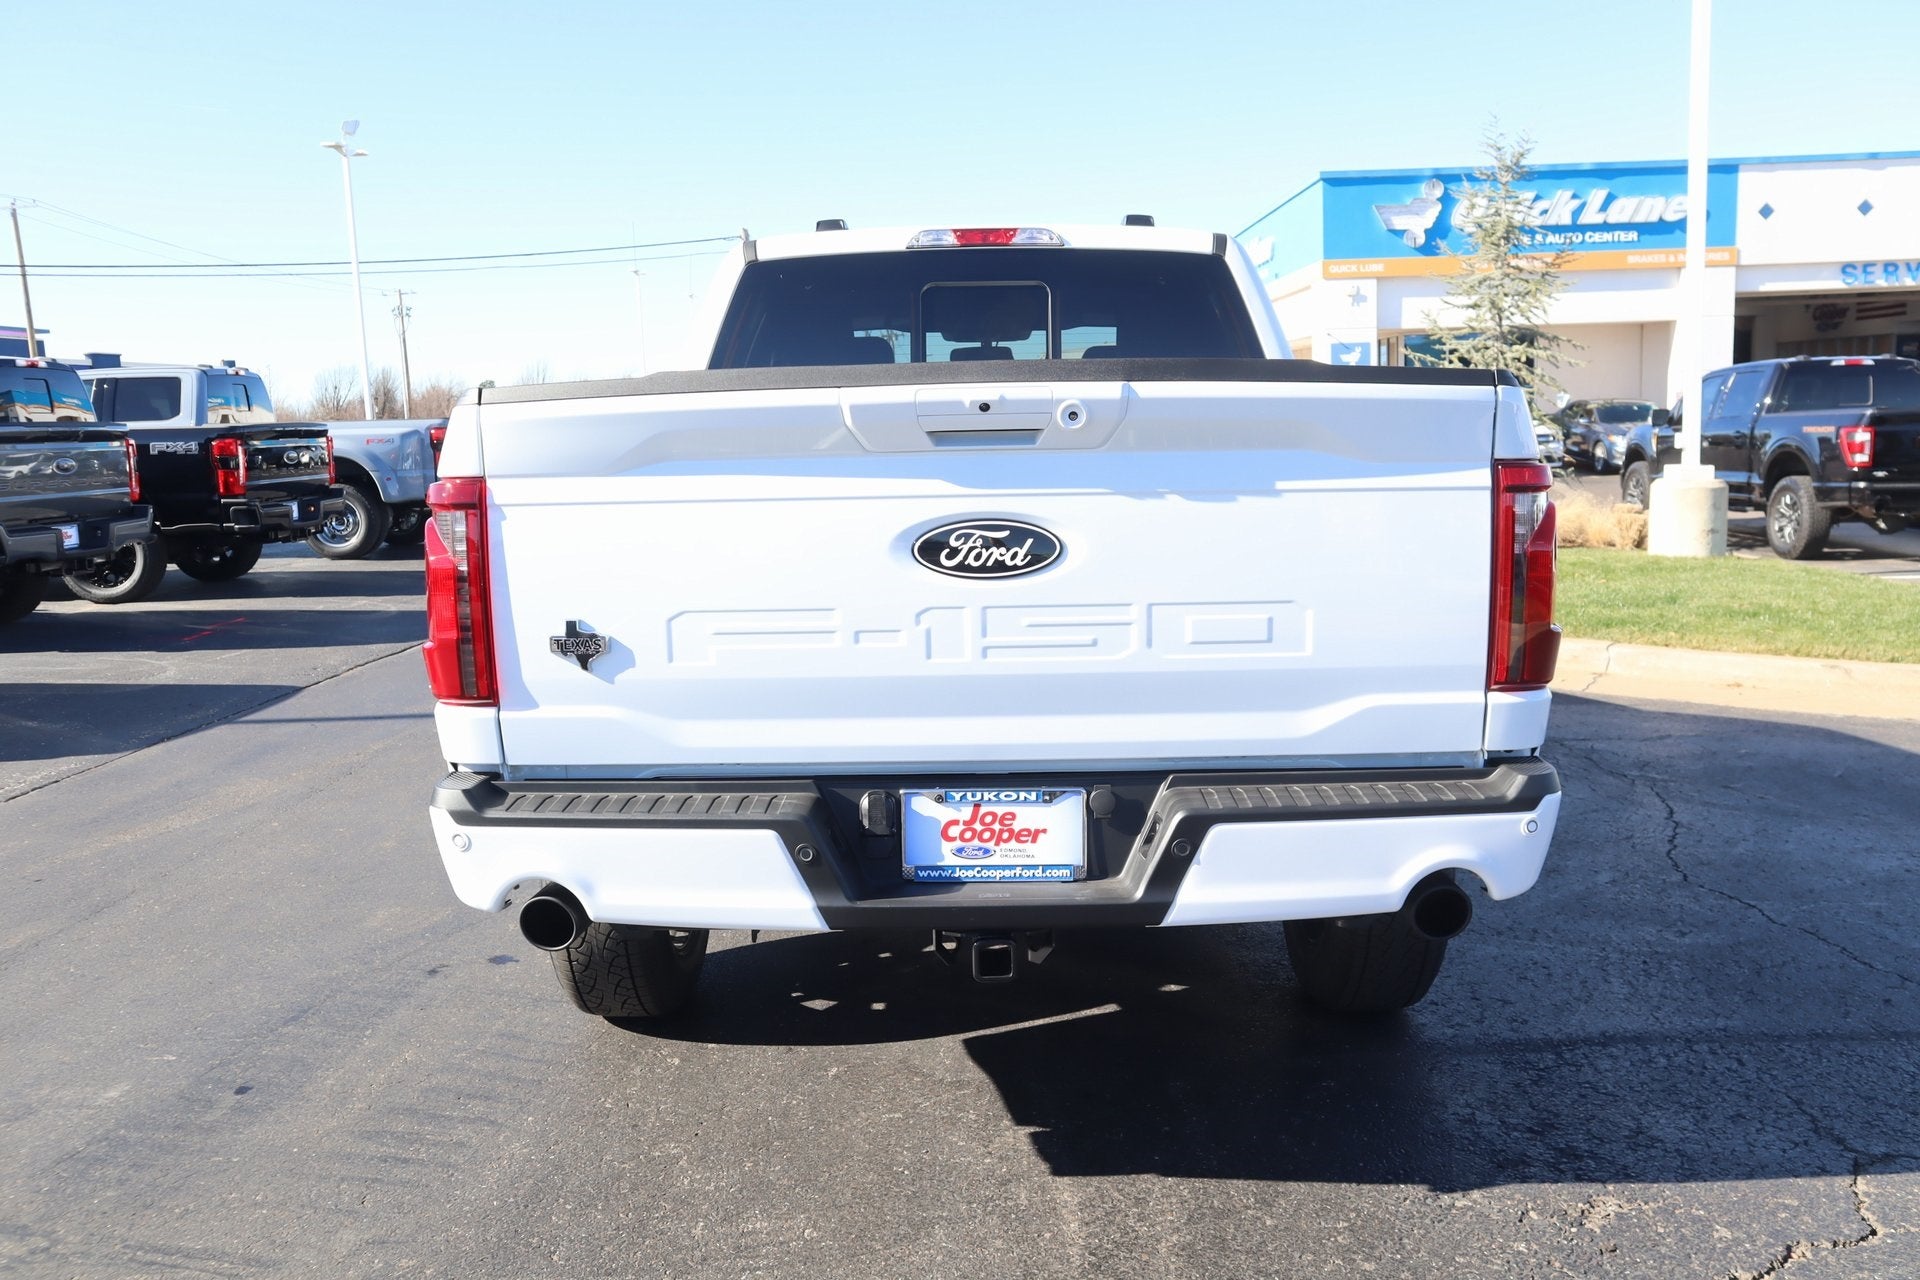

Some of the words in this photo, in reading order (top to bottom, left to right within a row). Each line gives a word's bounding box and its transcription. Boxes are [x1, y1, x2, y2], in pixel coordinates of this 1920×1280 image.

[1577, 187, 1690, 224] Lane
[1545, 232, 1583, 244] AUTO
[1584, 230, 1639, 243] CENTER
[1626, 253, 1667, 264] BRAKES
[1329, 264, 1357, 273] QUICK
[1359, 263, 1384, 272] LUBE
[1841, 261, 1920, 285] SERV
[150, 441, 199, 454] FX4
[939, 528, 1035, 569] Ford
[666, 600, 1314, 667] F-150
[553, 638, 602, 651] TEXAS
[949, 791, 1038, 801] YUKON
[963, 803, 1017, 827] Joe
[940, 819, 1048, 846] Cooper
[961, 846, 986, 857] Ford
[917, 866, 1071, 880] www.JoeCooperFord.com
